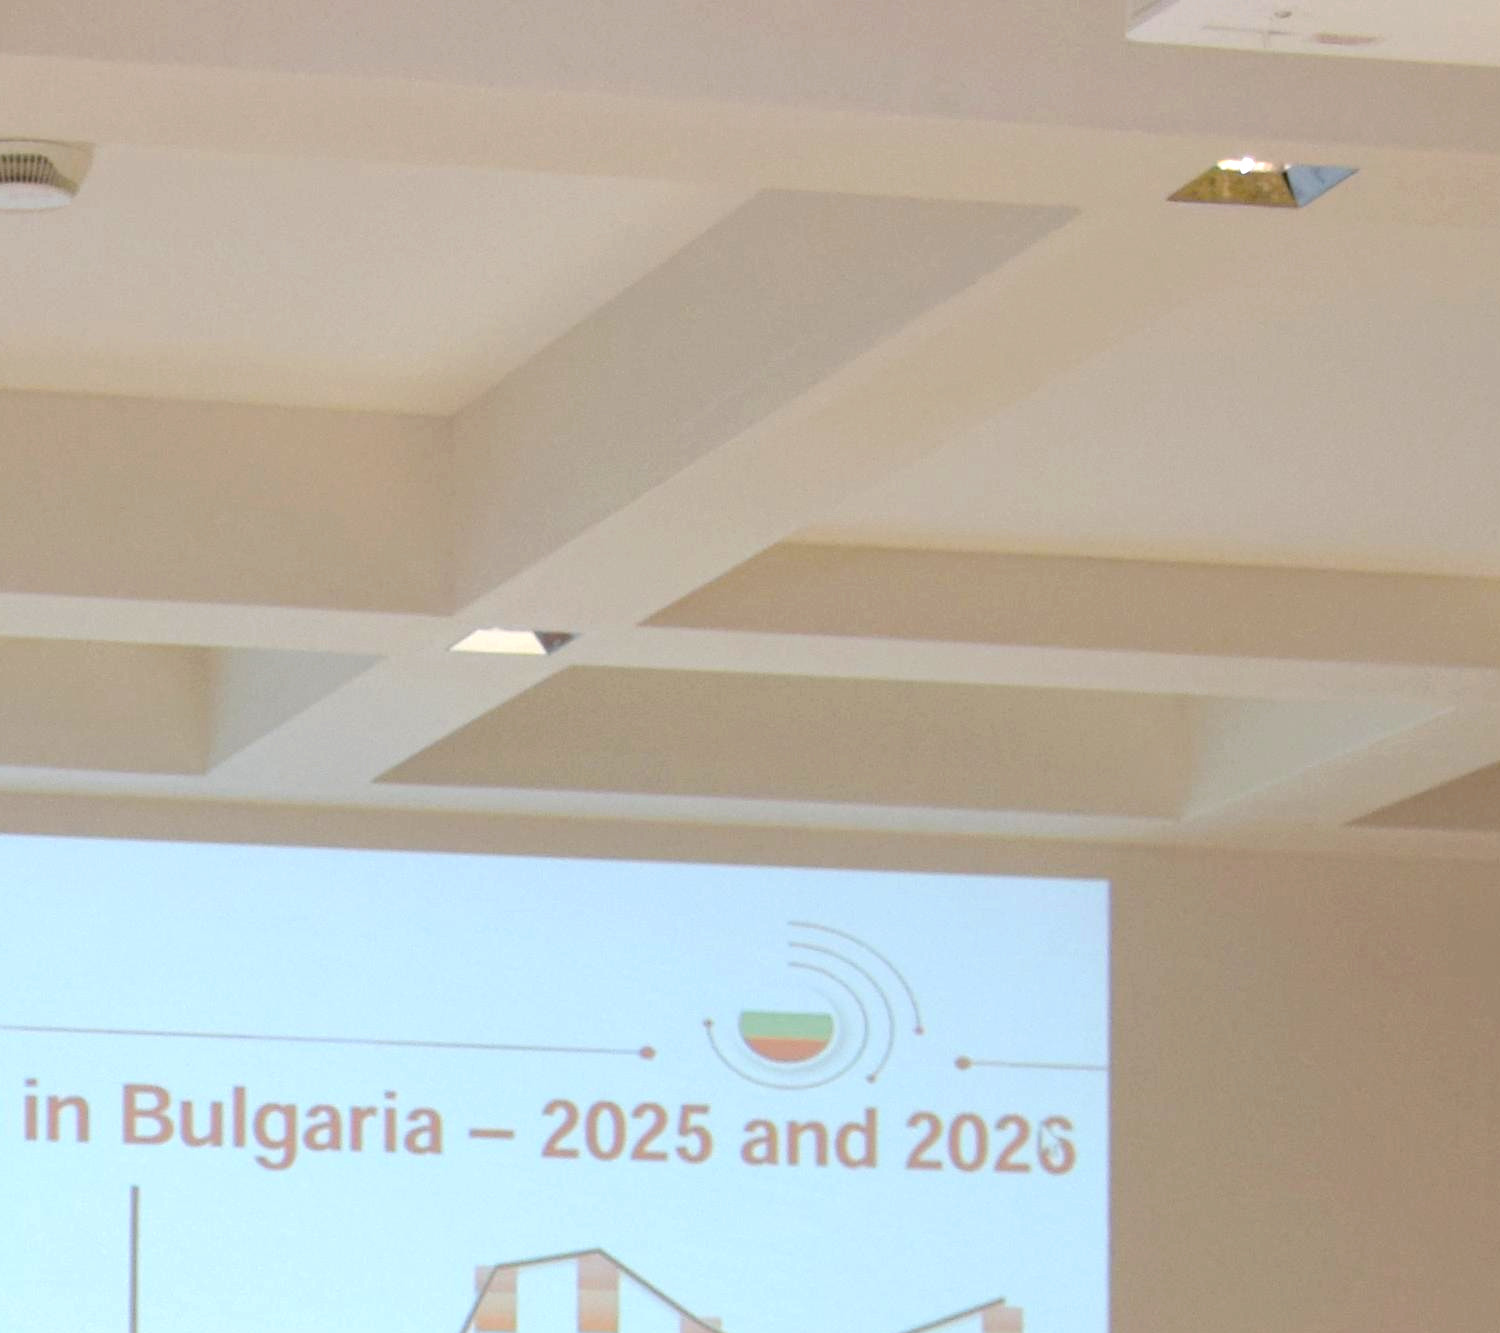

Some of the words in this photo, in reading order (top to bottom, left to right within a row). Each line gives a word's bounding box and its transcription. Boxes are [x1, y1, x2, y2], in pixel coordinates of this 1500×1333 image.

[25, 1076, 90, 1142] in
[123, 1084, 443, 1170] Bulgaria
[542, 1100, 713, 1163] 2025
[740, 1107, 877, 1168] and
[906, 1112, 1077, 1176] 2026
